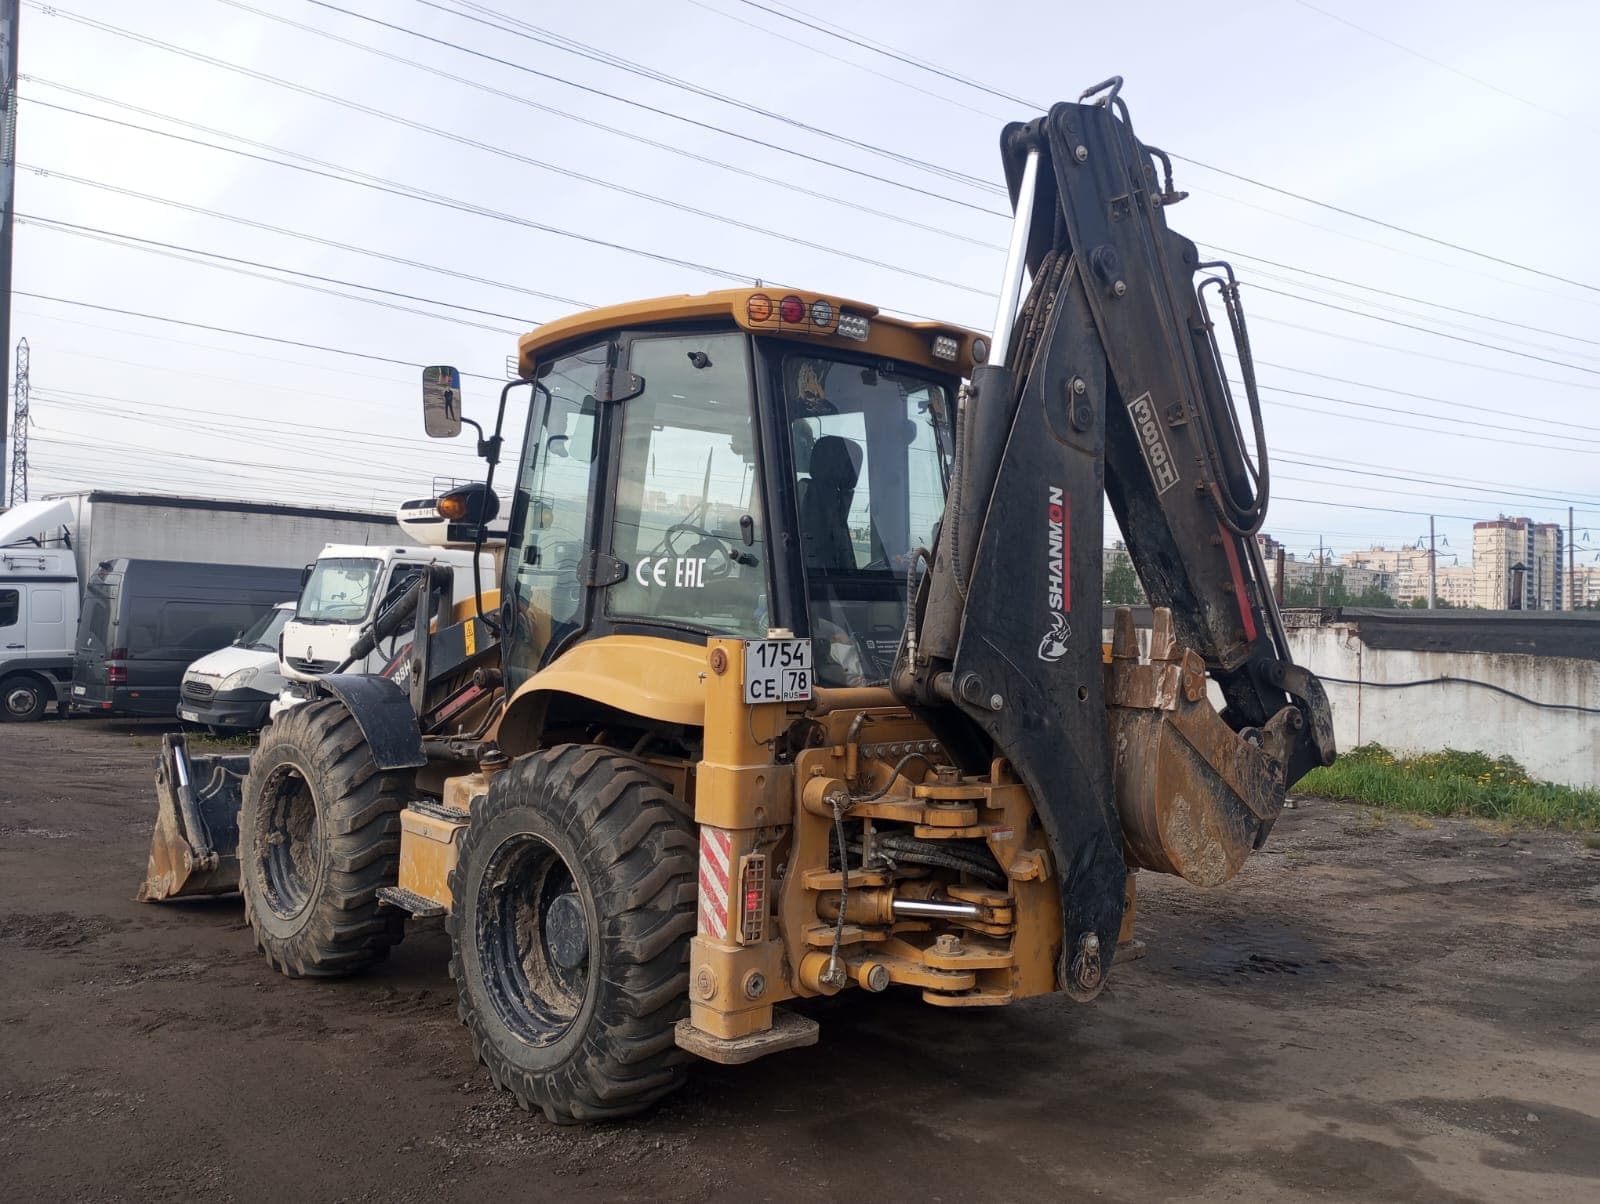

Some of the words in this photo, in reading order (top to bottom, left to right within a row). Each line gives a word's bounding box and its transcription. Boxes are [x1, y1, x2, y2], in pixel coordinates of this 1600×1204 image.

[1135, 400, 1174, 489] 388H
[1048, 485, 1064, 610] SHANMON
[756, 642, 804, 668] 1754
[750, 679, 775, 699] CE
[788, 671, 807, 691] 78
[783, 692, 799, 700] RUS
